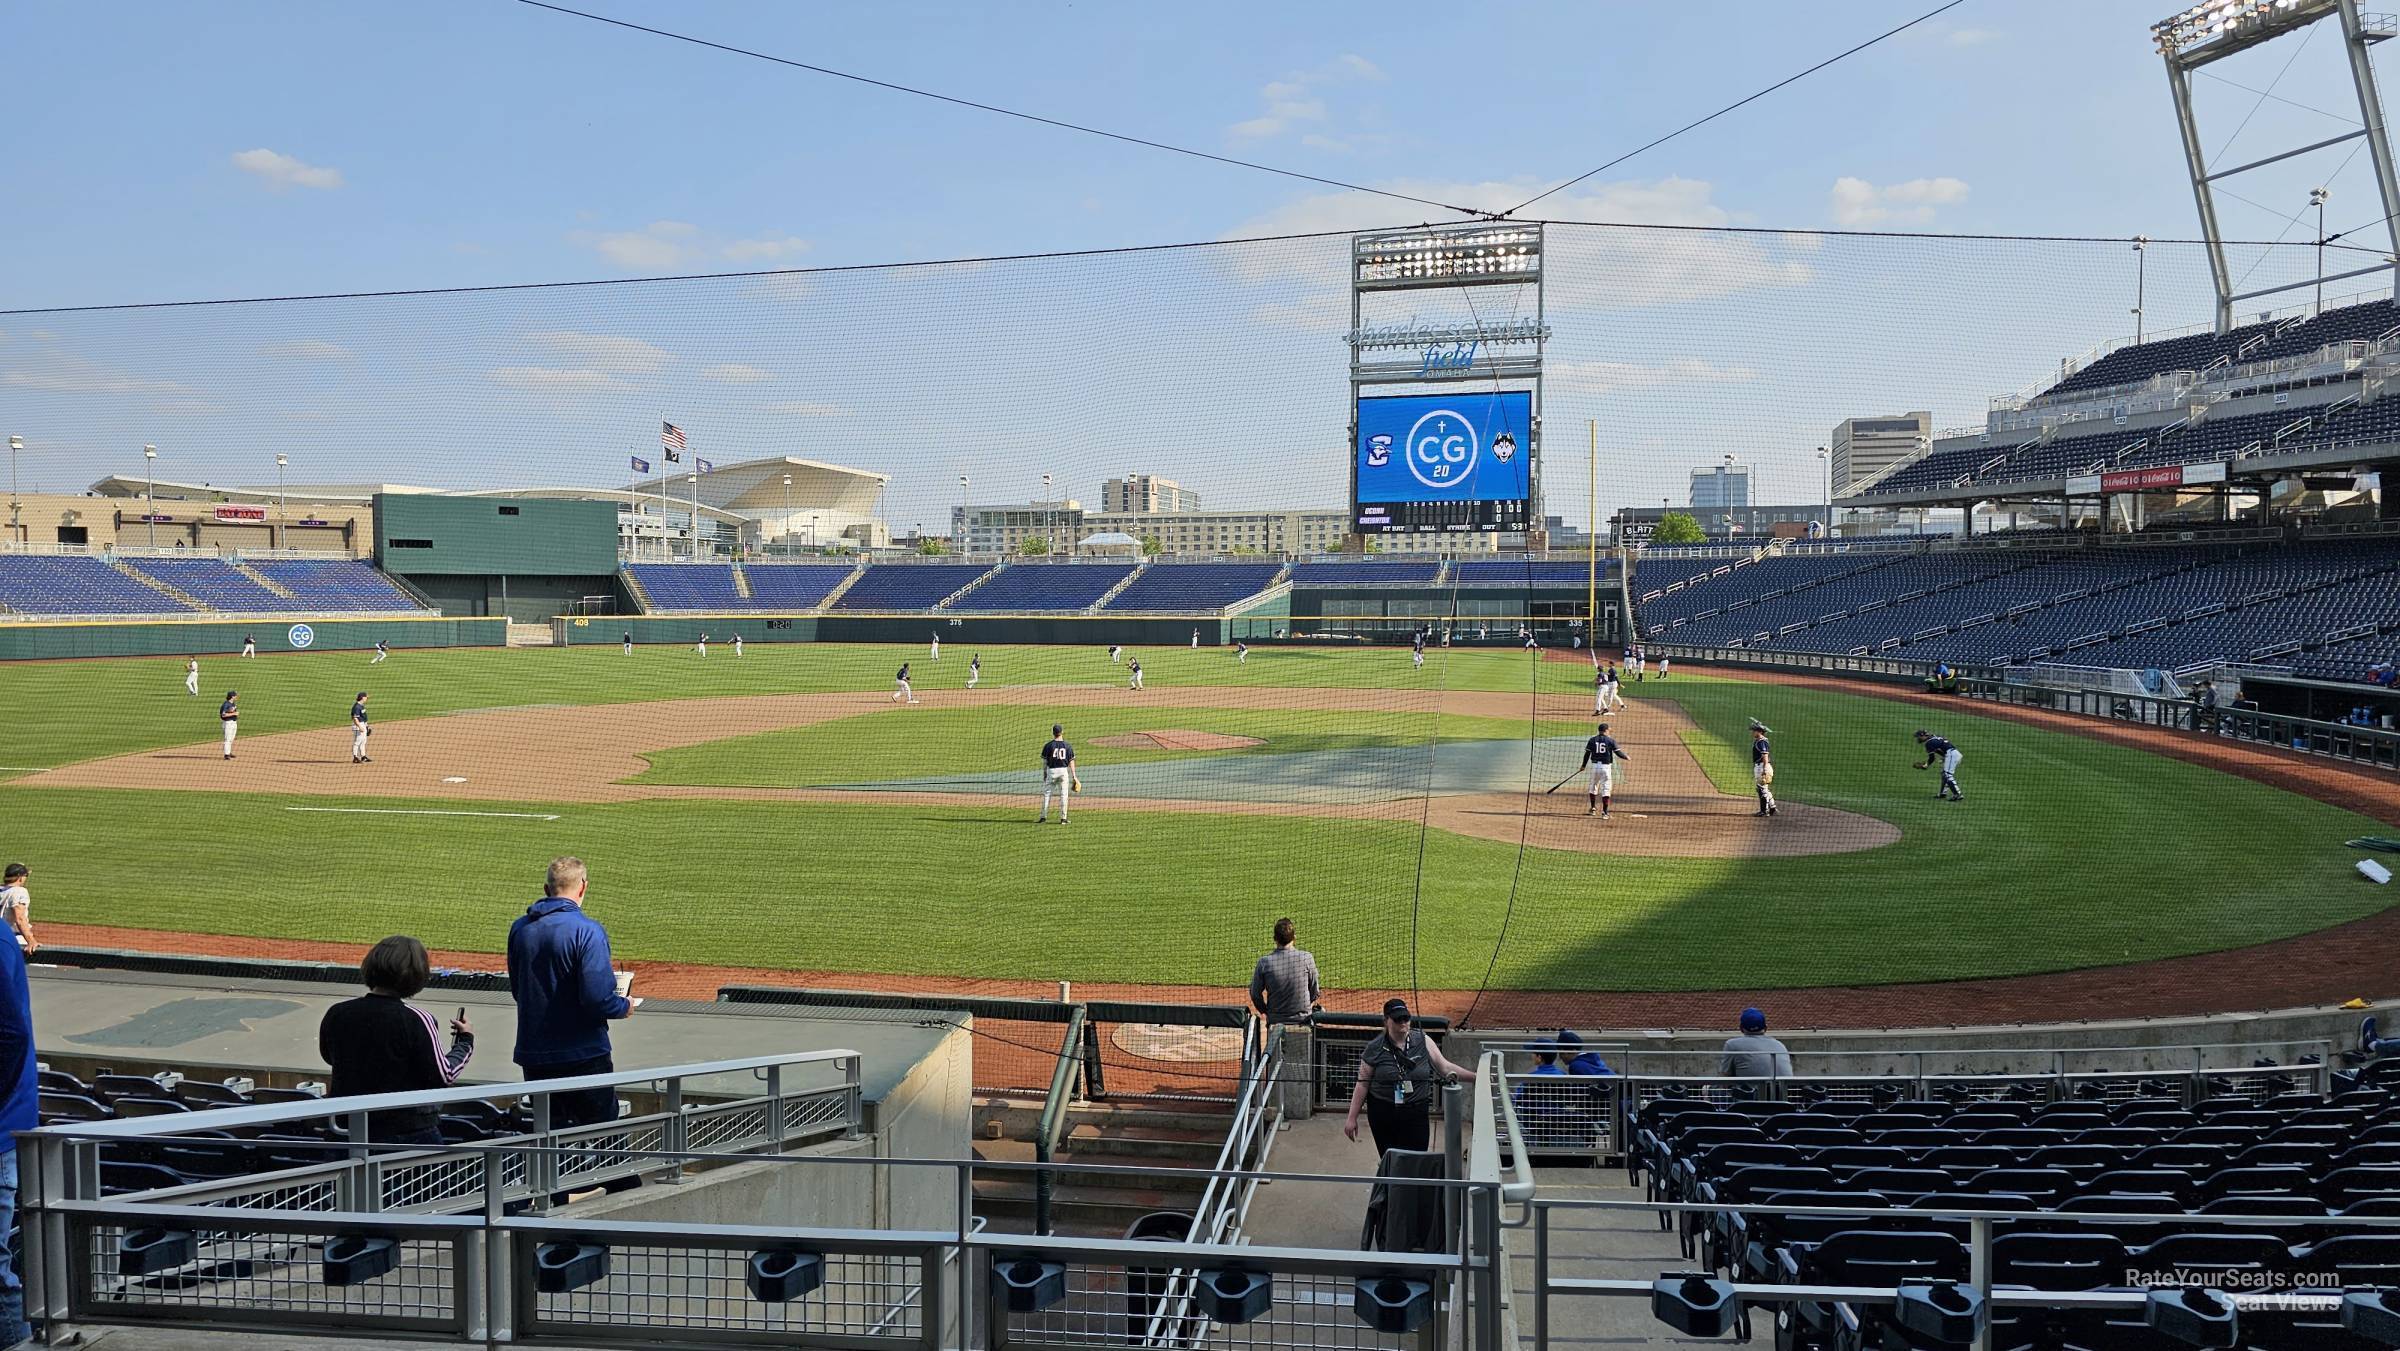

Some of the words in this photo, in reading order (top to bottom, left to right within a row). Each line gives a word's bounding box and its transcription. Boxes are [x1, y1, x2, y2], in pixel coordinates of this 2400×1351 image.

[1345, 315, 1441, 346] charles
[1412, 341, 1479, 377] field
[1426, 369, 1471, 379] OMAHA
[1418, 435, 1466, 464] CG
[1433, 465, 1450, 478] 20
[1626, 526, 1654, 535] BLATT
[773, 620, 790, 629] 0:20
[292, 632, 310, 640] CG
[1052, 748, 1066, 760] 40
[1595, 742, 1606, 754] 16
